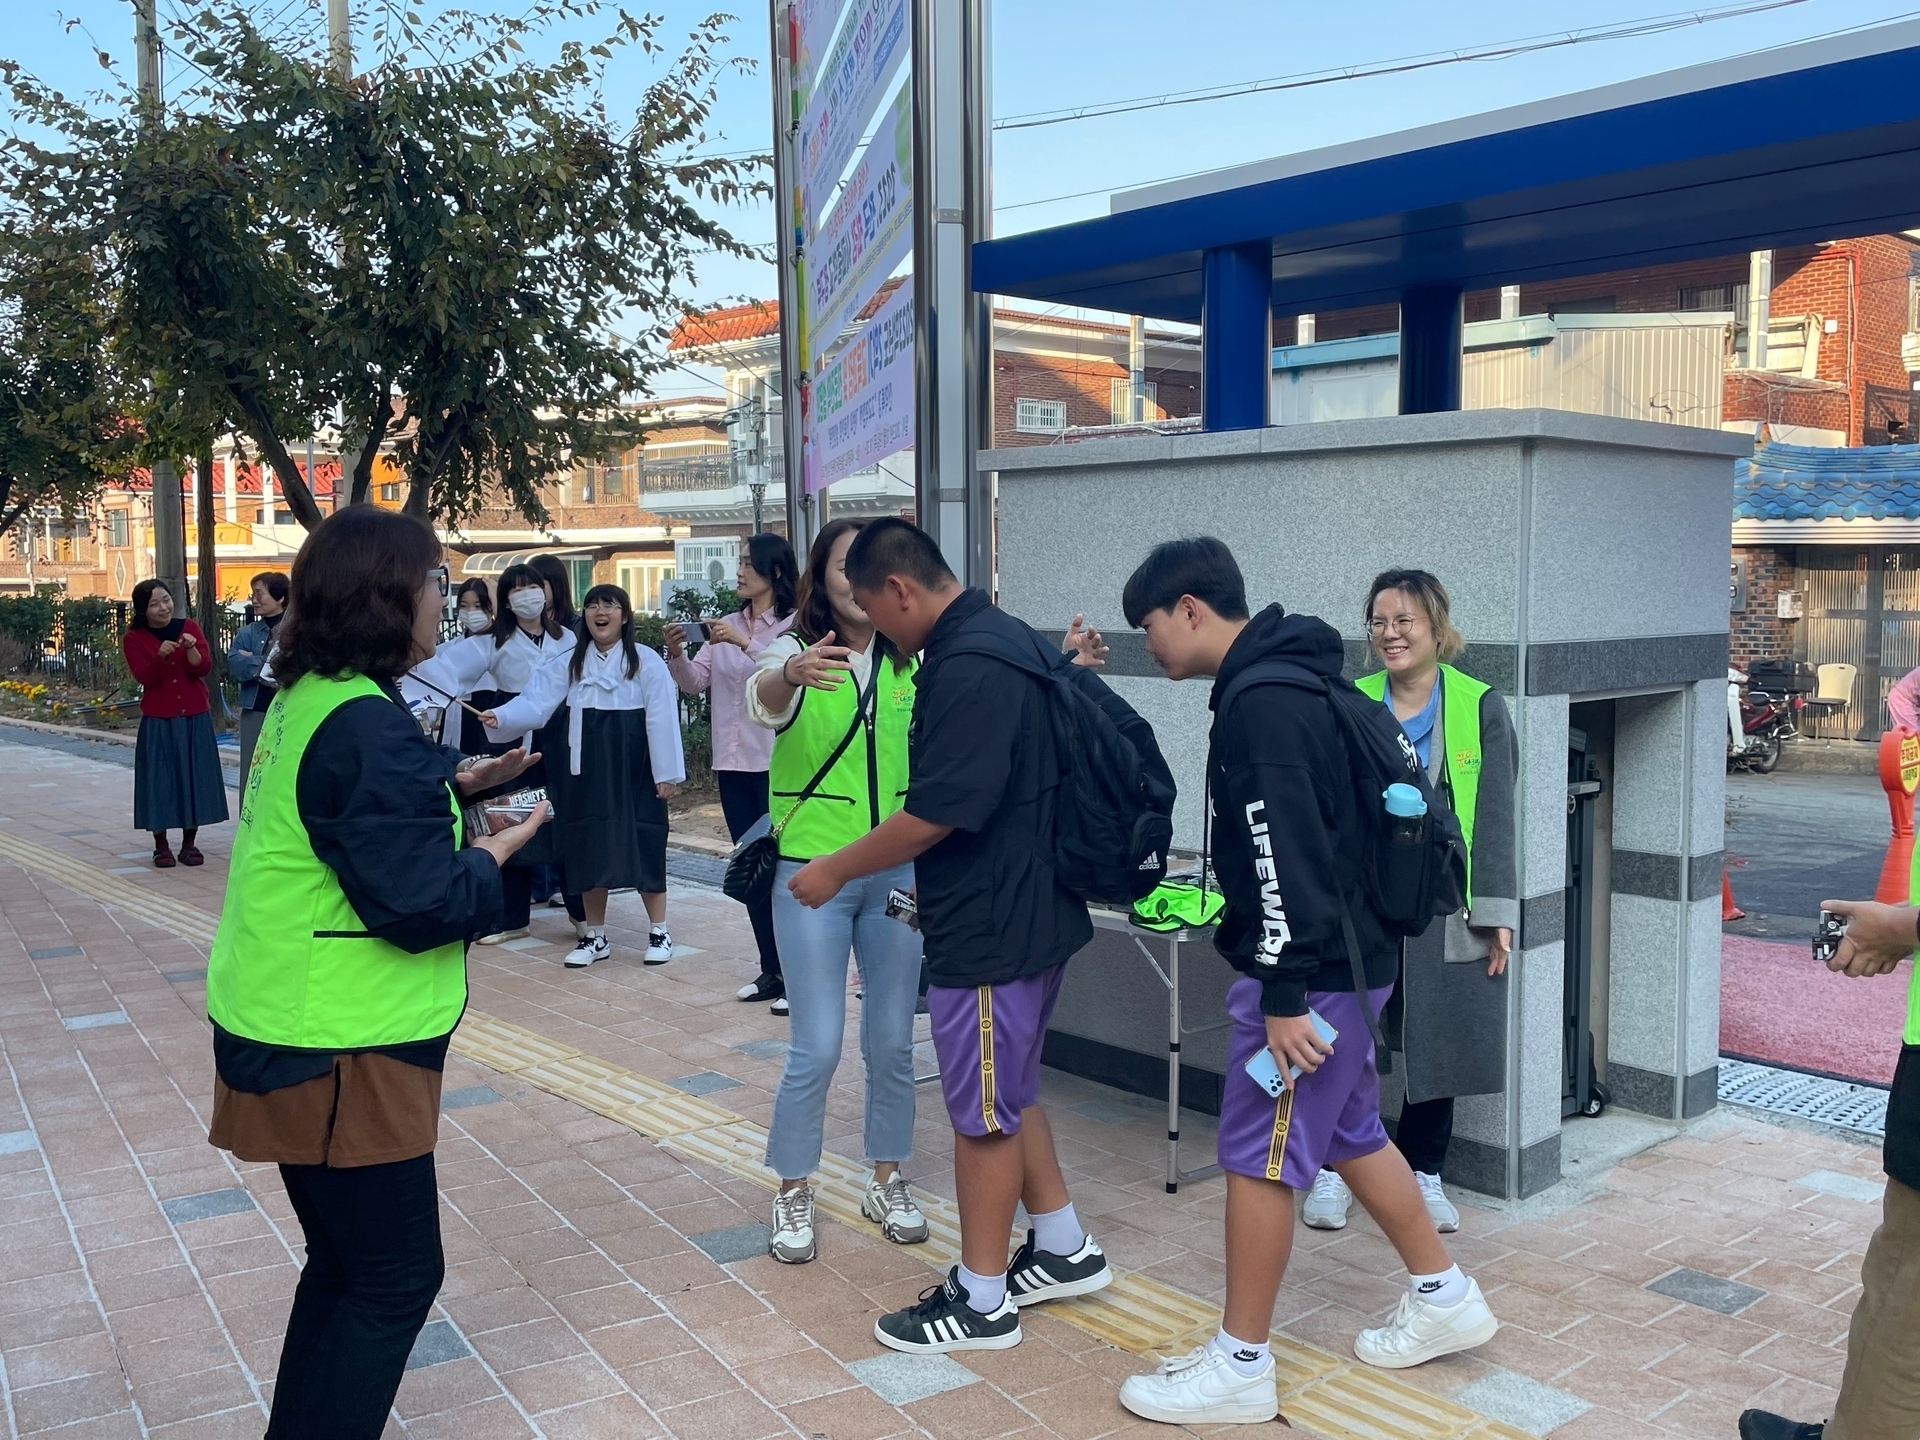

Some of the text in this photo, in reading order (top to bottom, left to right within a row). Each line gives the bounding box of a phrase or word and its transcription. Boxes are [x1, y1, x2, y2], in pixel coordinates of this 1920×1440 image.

[509, 788, 547, 807] HERSHEY'S
[1421, 1280, 1442, 1289] NIKE
[1240, 1348, 1259, 1360] NIKE
